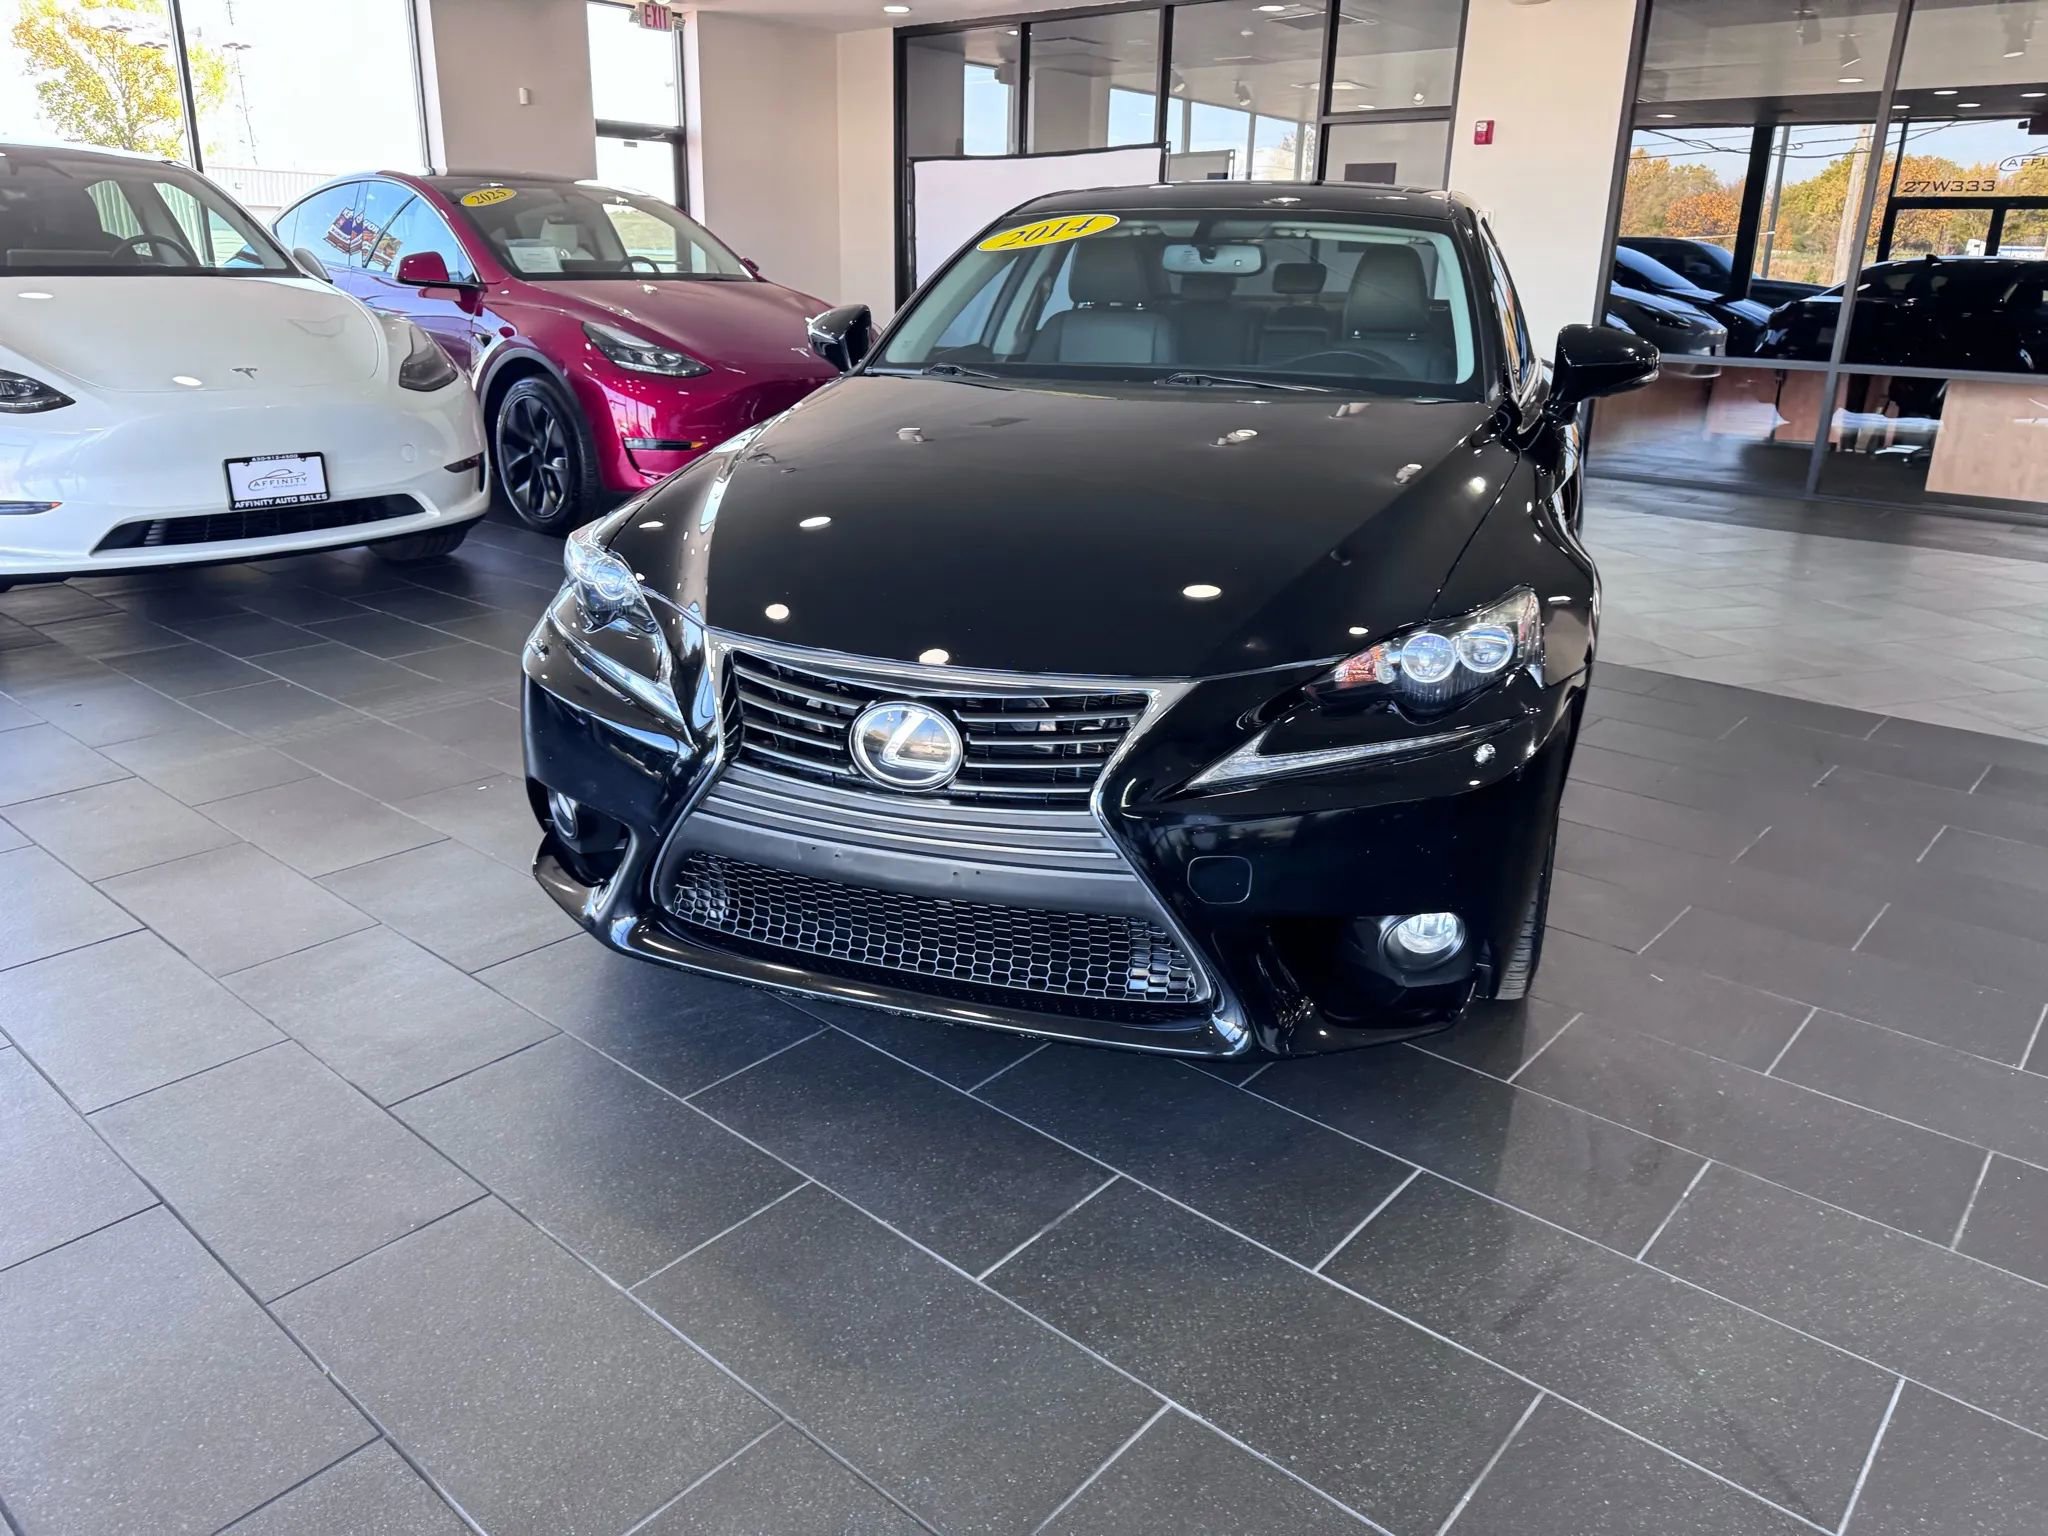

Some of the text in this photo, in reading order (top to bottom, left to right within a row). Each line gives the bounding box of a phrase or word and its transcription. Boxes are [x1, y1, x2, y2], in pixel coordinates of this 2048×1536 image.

[644, 4, 668, 29] EXIT
[1903, 180, 1996, 193] 27W333
[471, 189, 507, 204] 2025
[999, 215, 1098, 248] 2014
[253, 476, 308, 488] AFFINITY
[234, 493, 328, 509] AFFINITY AUTO SALES
